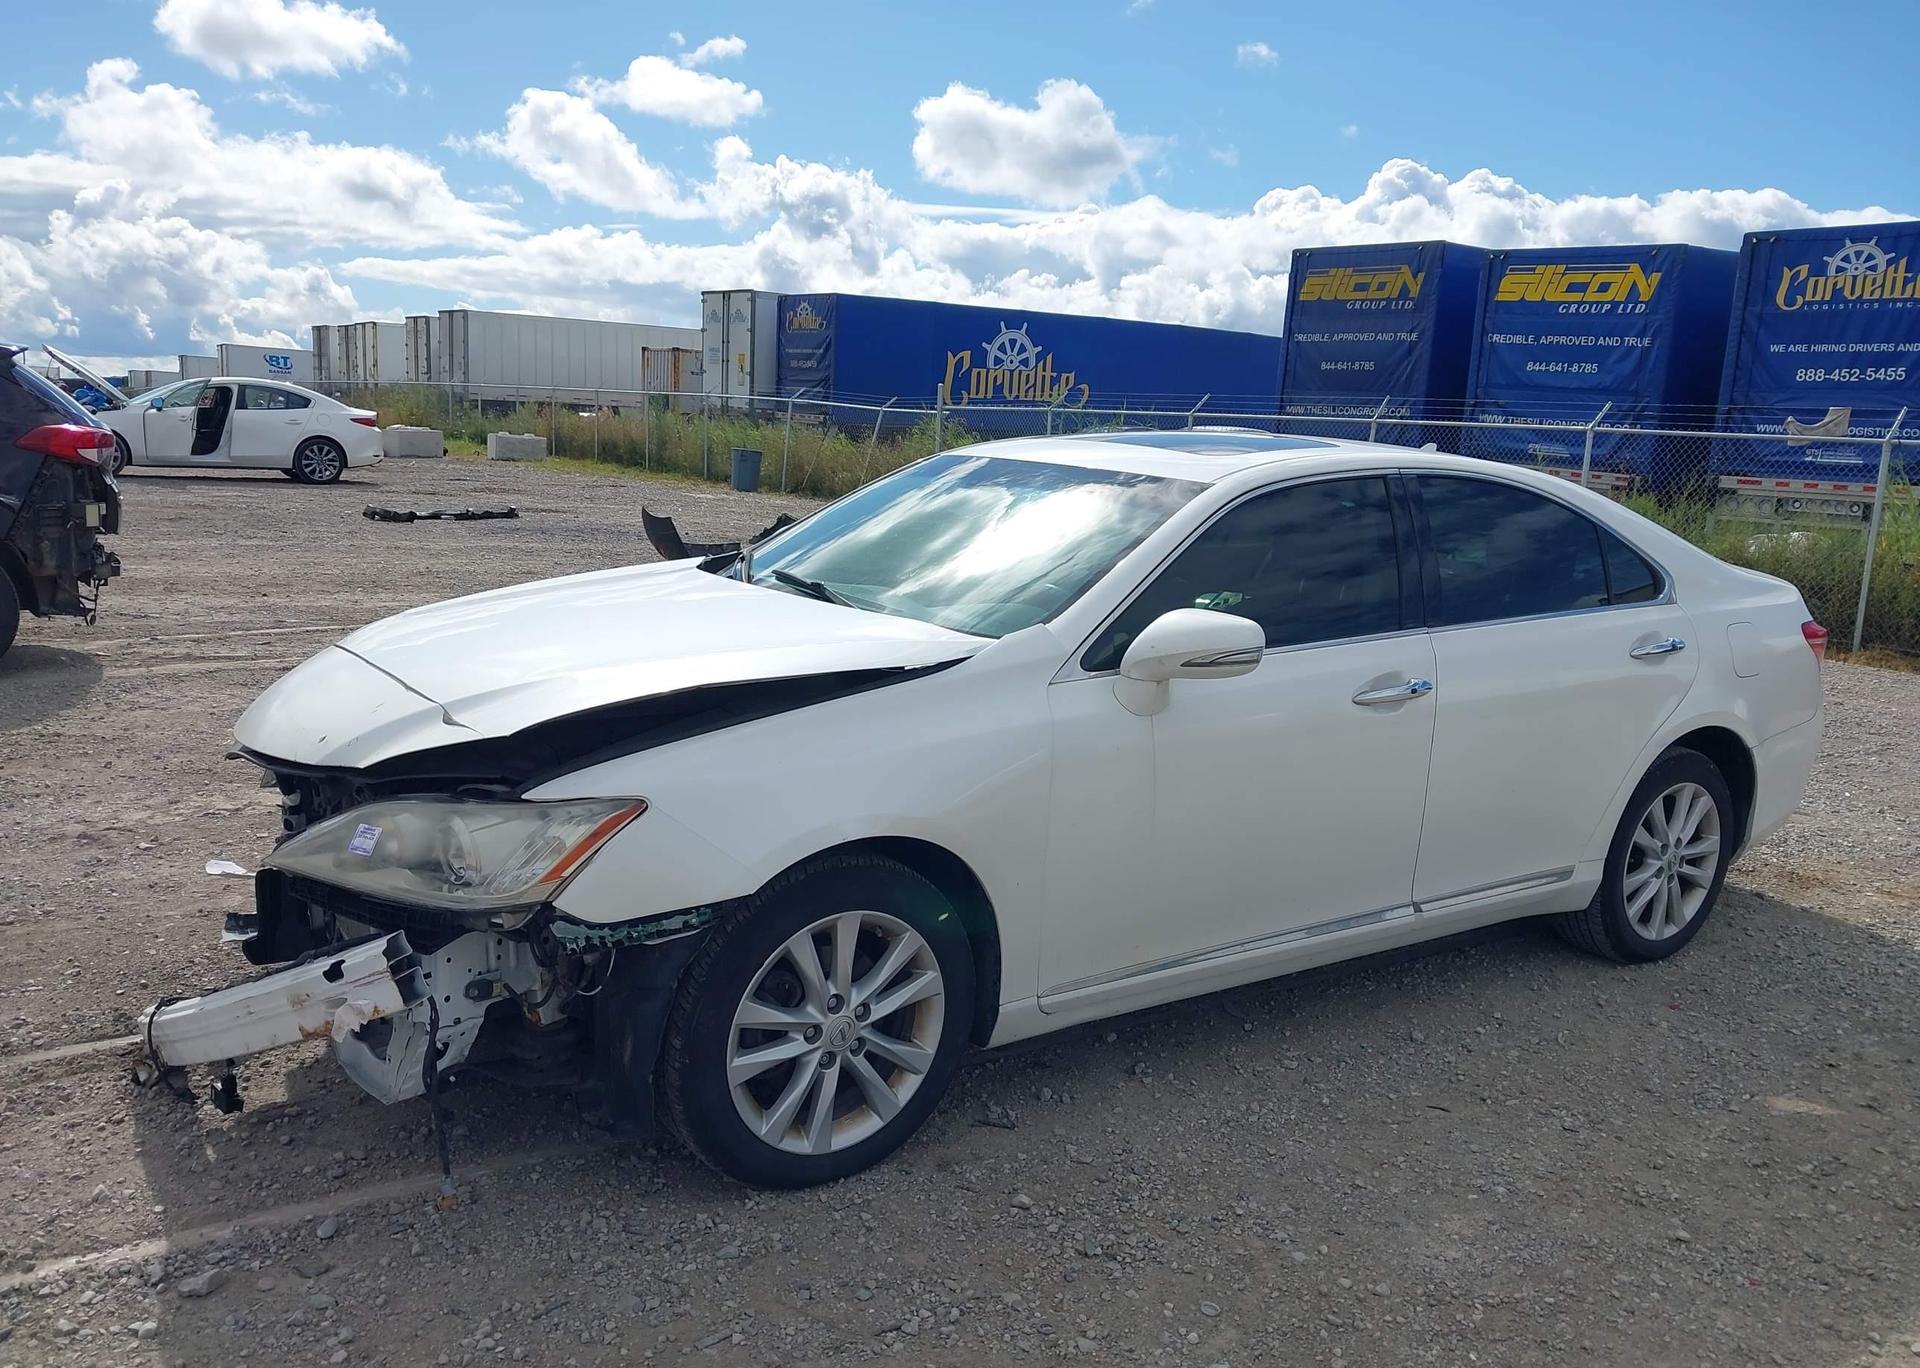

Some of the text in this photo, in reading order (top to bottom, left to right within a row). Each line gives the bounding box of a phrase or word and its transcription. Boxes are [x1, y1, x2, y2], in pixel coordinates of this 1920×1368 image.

[1346, 300, 1416, 310] GROUP LTD.
[1558, 303, 1612, 314] GROUP
[1804, 302, 1880, 311] LOGISTICS
[1294, 332, 1419, 342] CREDIBLE, APPROVED AND TRUE
[1487, 333, 1653, 347] CREDIBLE, APPROVED AND TRUE
[1770, 343, 1920, 353] WE ARE HIRING DRIVERS AND
[1320, 361, 1376, 371] 844-641-8785
[1526, 361, 1599, 374] 844-641-8785
[943, 350, 1090, 409] Corvette
[1796, 367, 1907, 382] 888-452-5455
